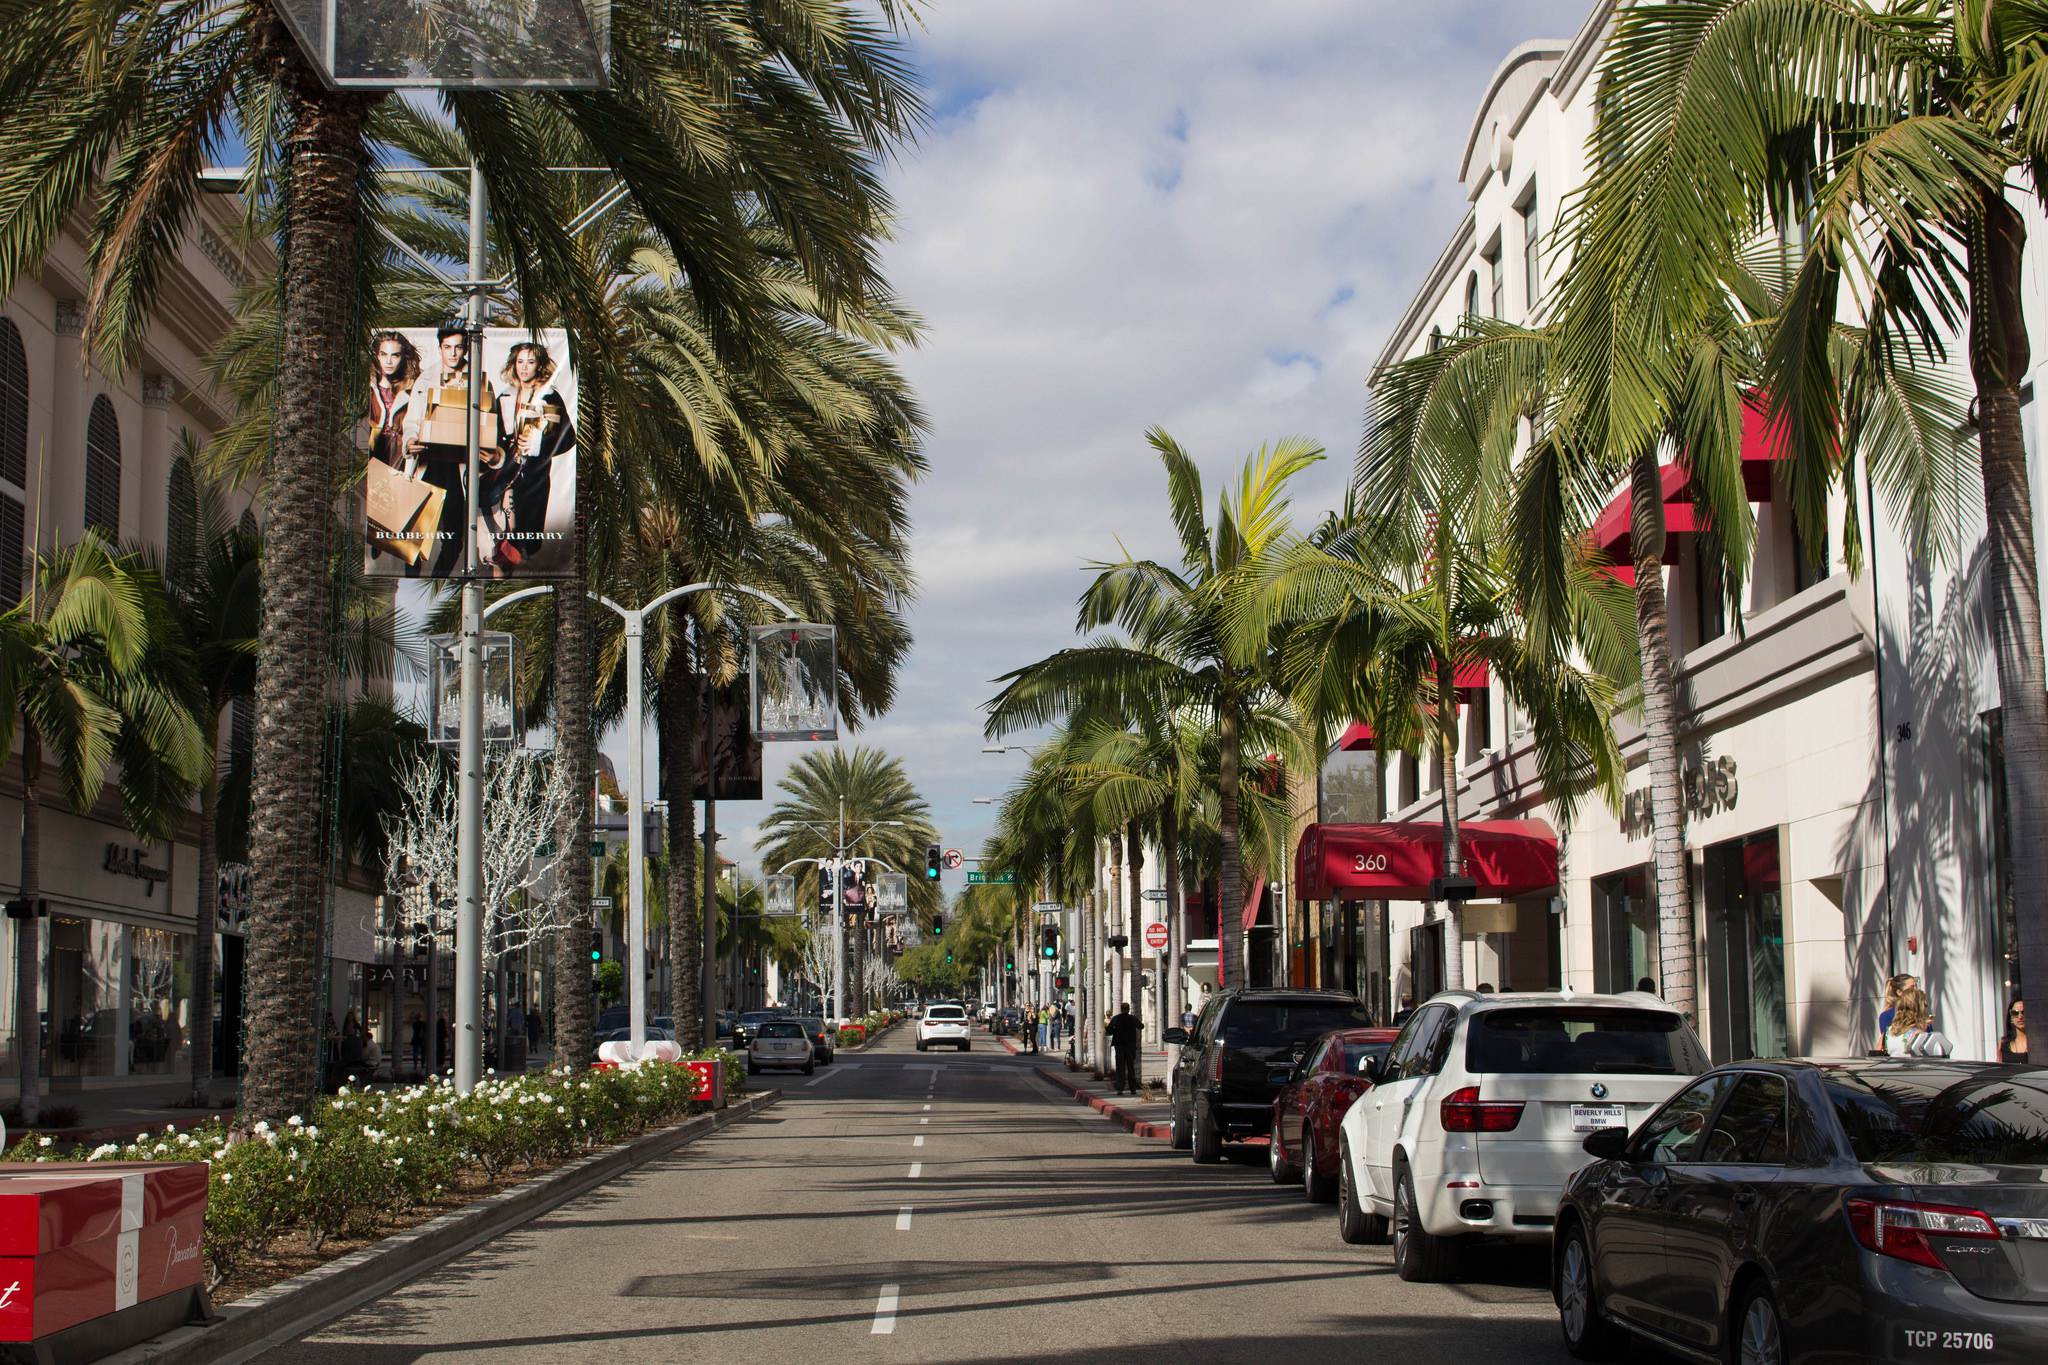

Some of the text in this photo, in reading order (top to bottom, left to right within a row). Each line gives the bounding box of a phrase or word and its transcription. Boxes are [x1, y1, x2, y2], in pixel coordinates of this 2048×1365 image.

[376, 531, 455, 540] BURBERRY
[487, 531, 565, 540] BURBERRY
[1897, 722, 1911, 743] 346
[1354, 853, 1387, 872] 360
[1905, 1330, 1994, 1350] TCP 25706
